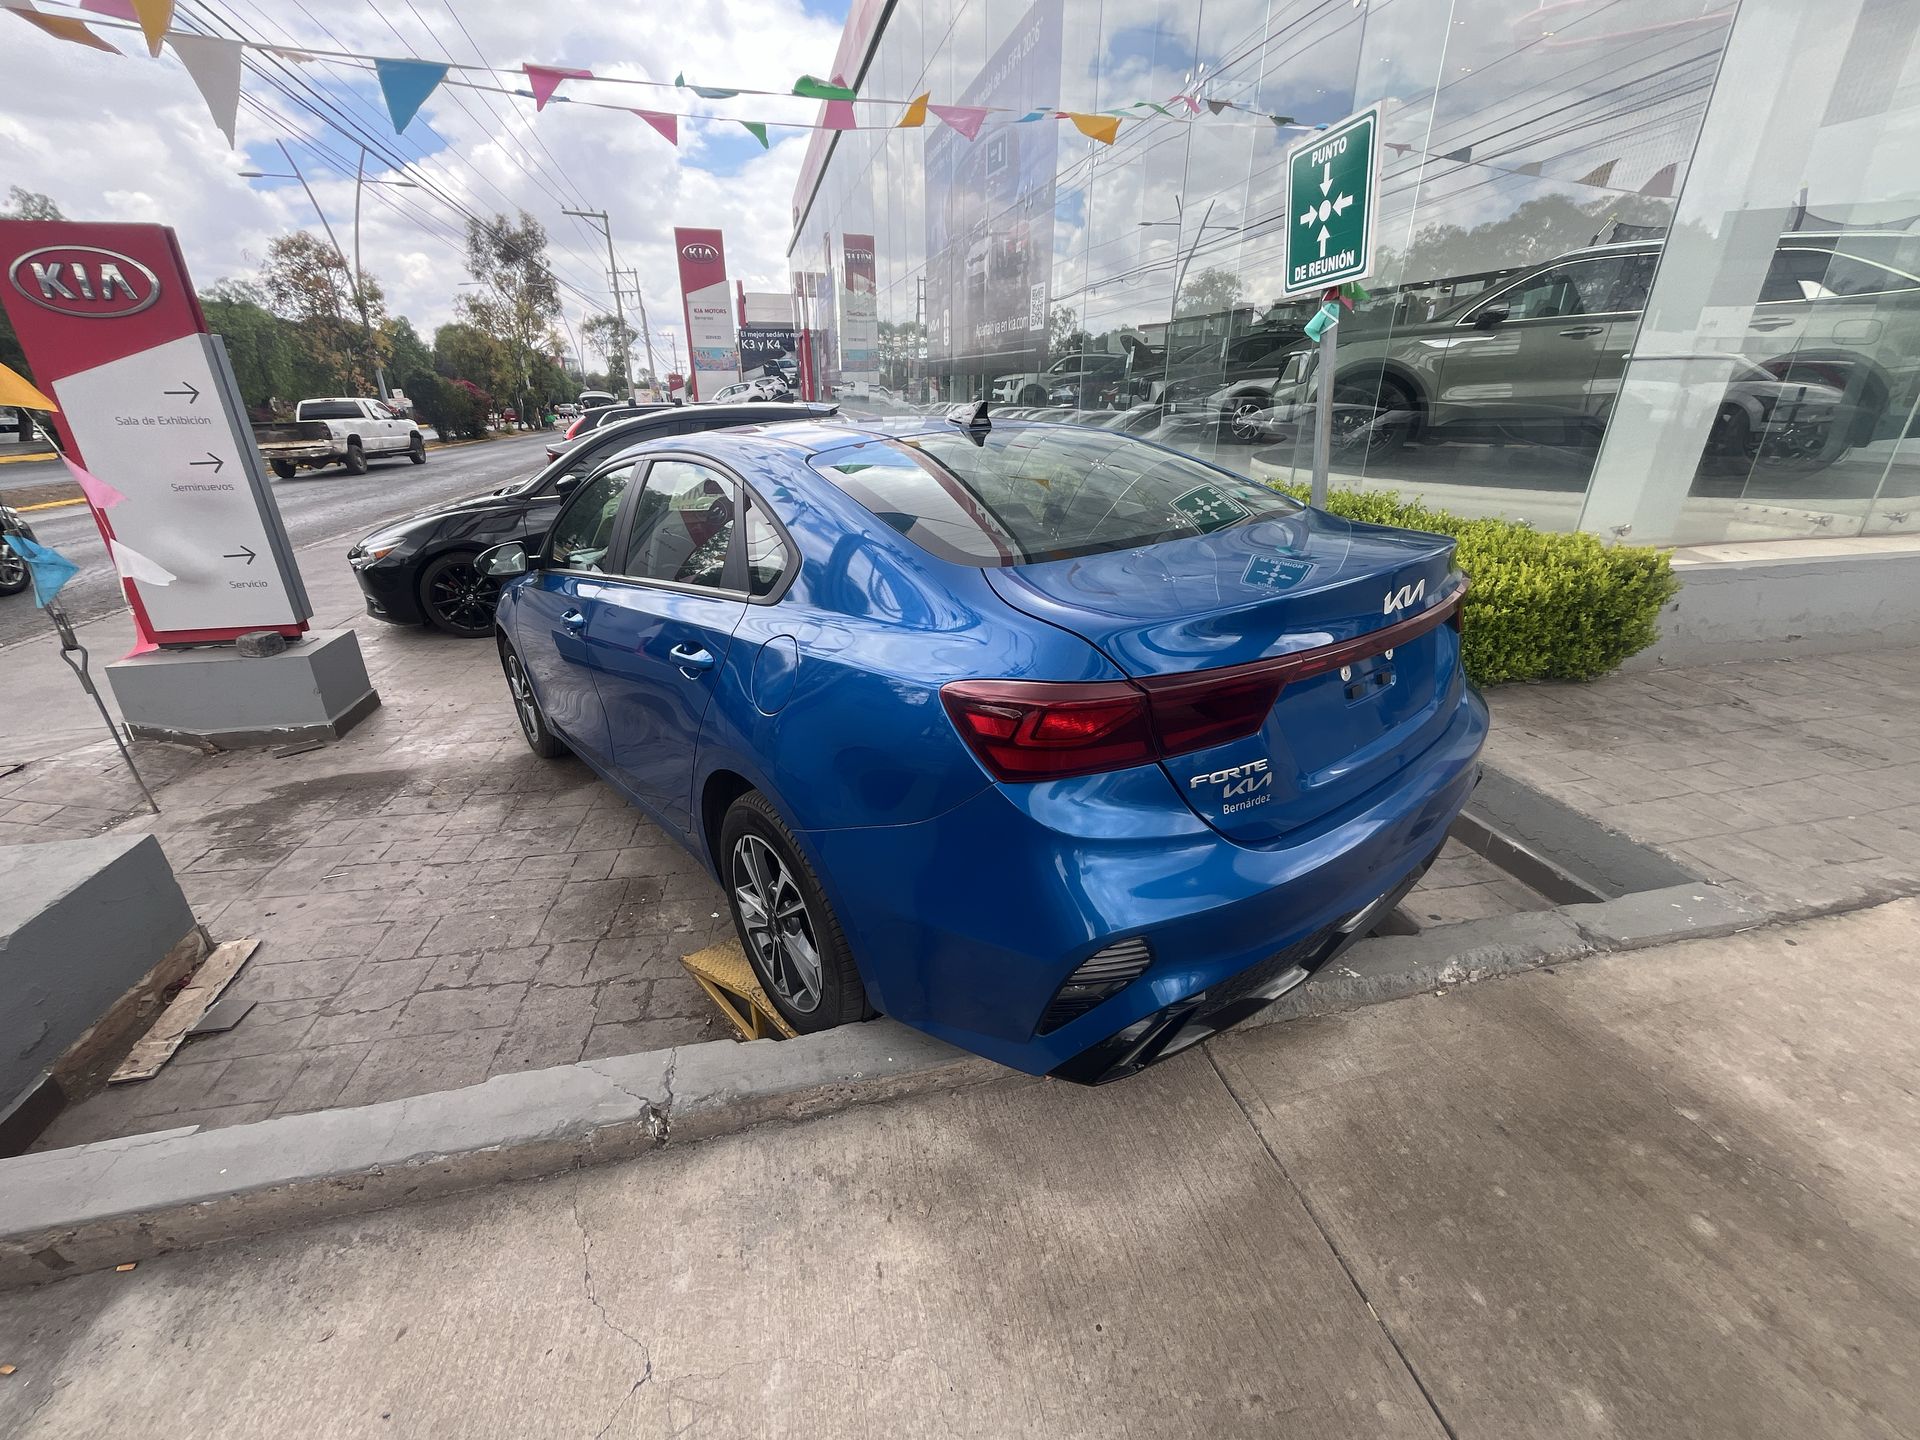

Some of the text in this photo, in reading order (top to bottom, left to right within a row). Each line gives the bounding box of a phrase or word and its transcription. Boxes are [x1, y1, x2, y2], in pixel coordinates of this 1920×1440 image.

[1007, 44, 1021, 74] FIFA
[1311, 136, 1348, 167] PUNTO
[688, 247, 713, 259] KIA
[1294, 249, 1355, 282] DE REUNIÓN
[29, 262, 139, 301] KIA
[741, 339, 781, 351] K3 y K4
[747, 331, 765, 339] mejor
[115, 416, 139, 426] Sala
[142, 416, 156, 426] de
[170, 483, 235, 492] Seminuevos
[229, 580, 268, 589] Servicio
[1383, 578, 1426, 615] KIA
[1190, 758, 1268, 789] FORTE
[1223, 771, 1273, 799] KIA
[1223, 794, 1271, 815] Bernárdez
